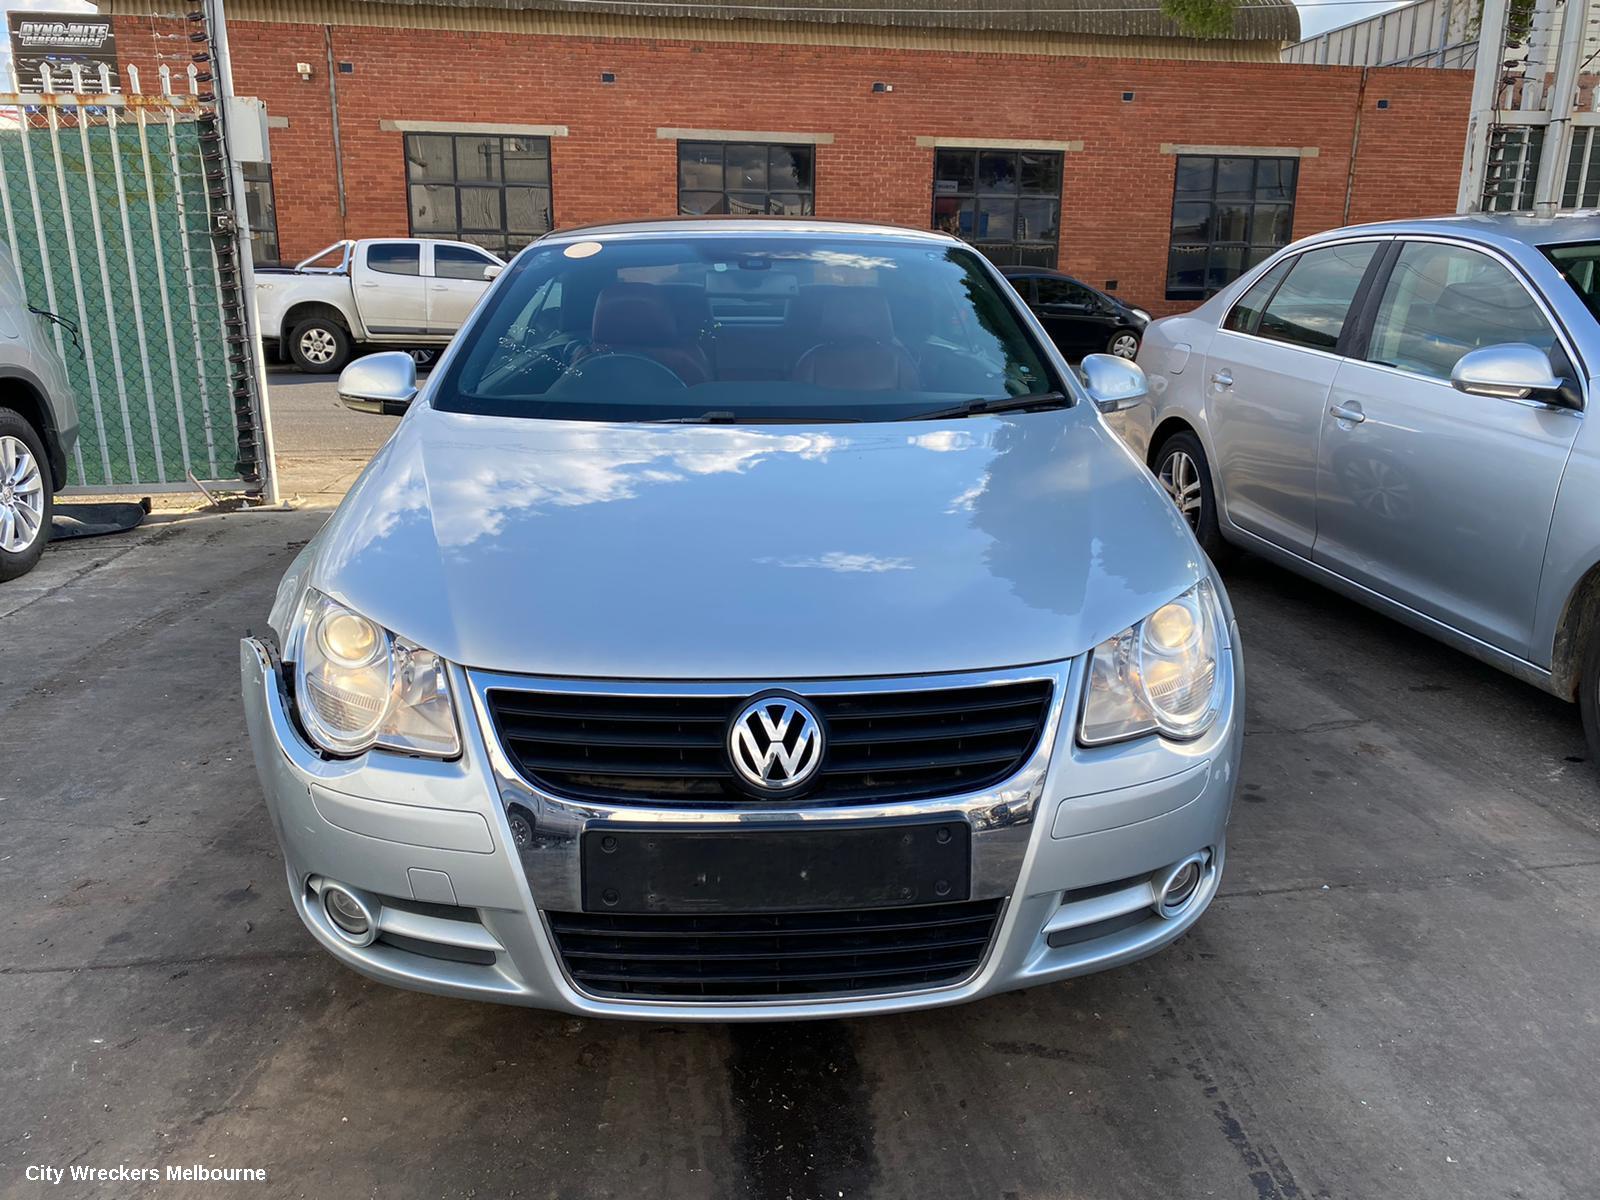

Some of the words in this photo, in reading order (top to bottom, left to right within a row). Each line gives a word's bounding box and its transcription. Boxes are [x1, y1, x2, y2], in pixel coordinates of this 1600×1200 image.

[21, 24, 107, 38] DYNO-MITE
[24, 36, 102, 46] PERFORMANCE
[731, 698, 821, 787] VW
